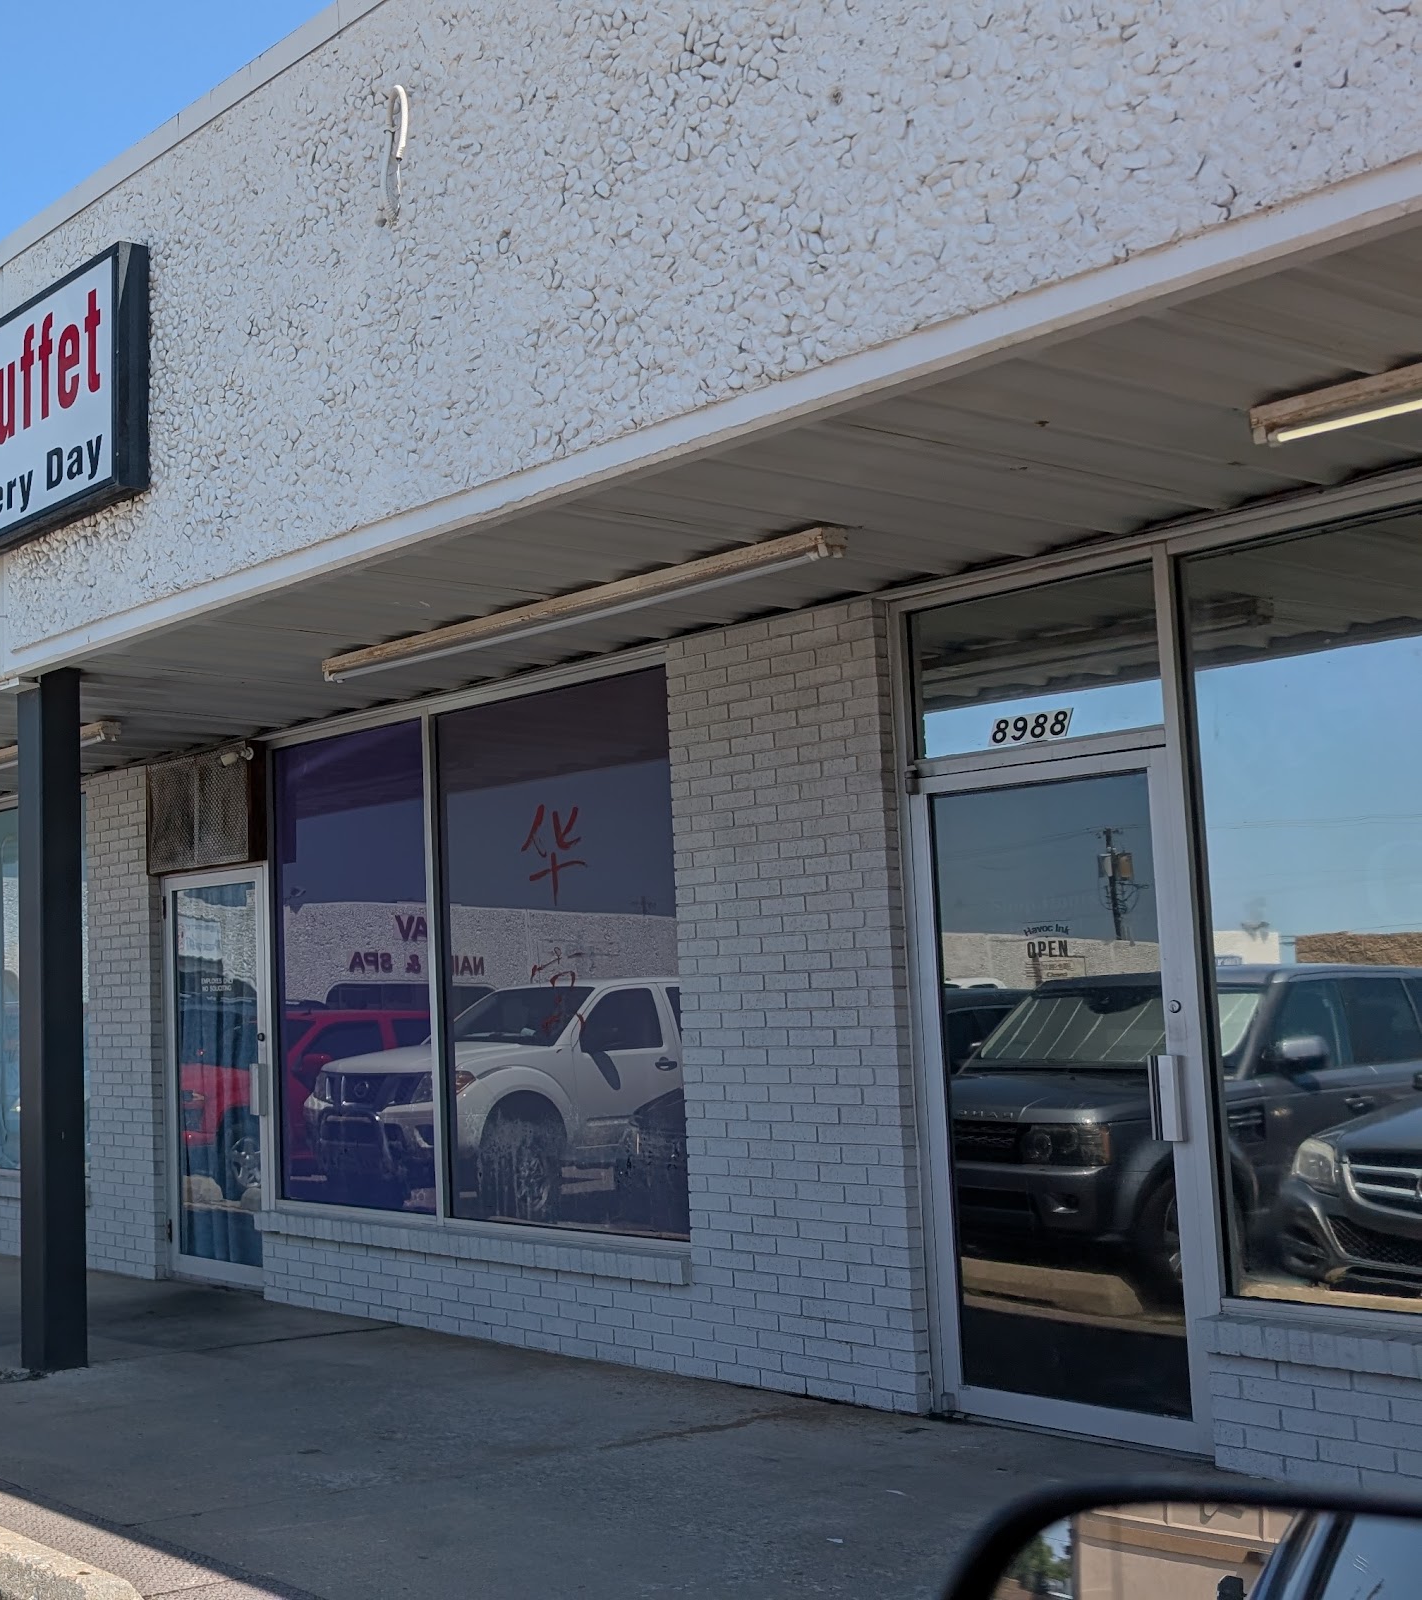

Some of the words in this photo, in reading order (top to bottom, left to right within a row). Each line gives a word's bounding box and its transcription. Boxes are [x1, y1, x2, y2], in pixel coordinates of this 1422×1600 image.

[46, 434, 103, 491] Day
[992, 710, 1068, 744] 8988
[1023, 924, 1054, 936] Havoc
[1055, 924, 1071, 935] Ink
[1026, 940, 1069, 958] OPEN
